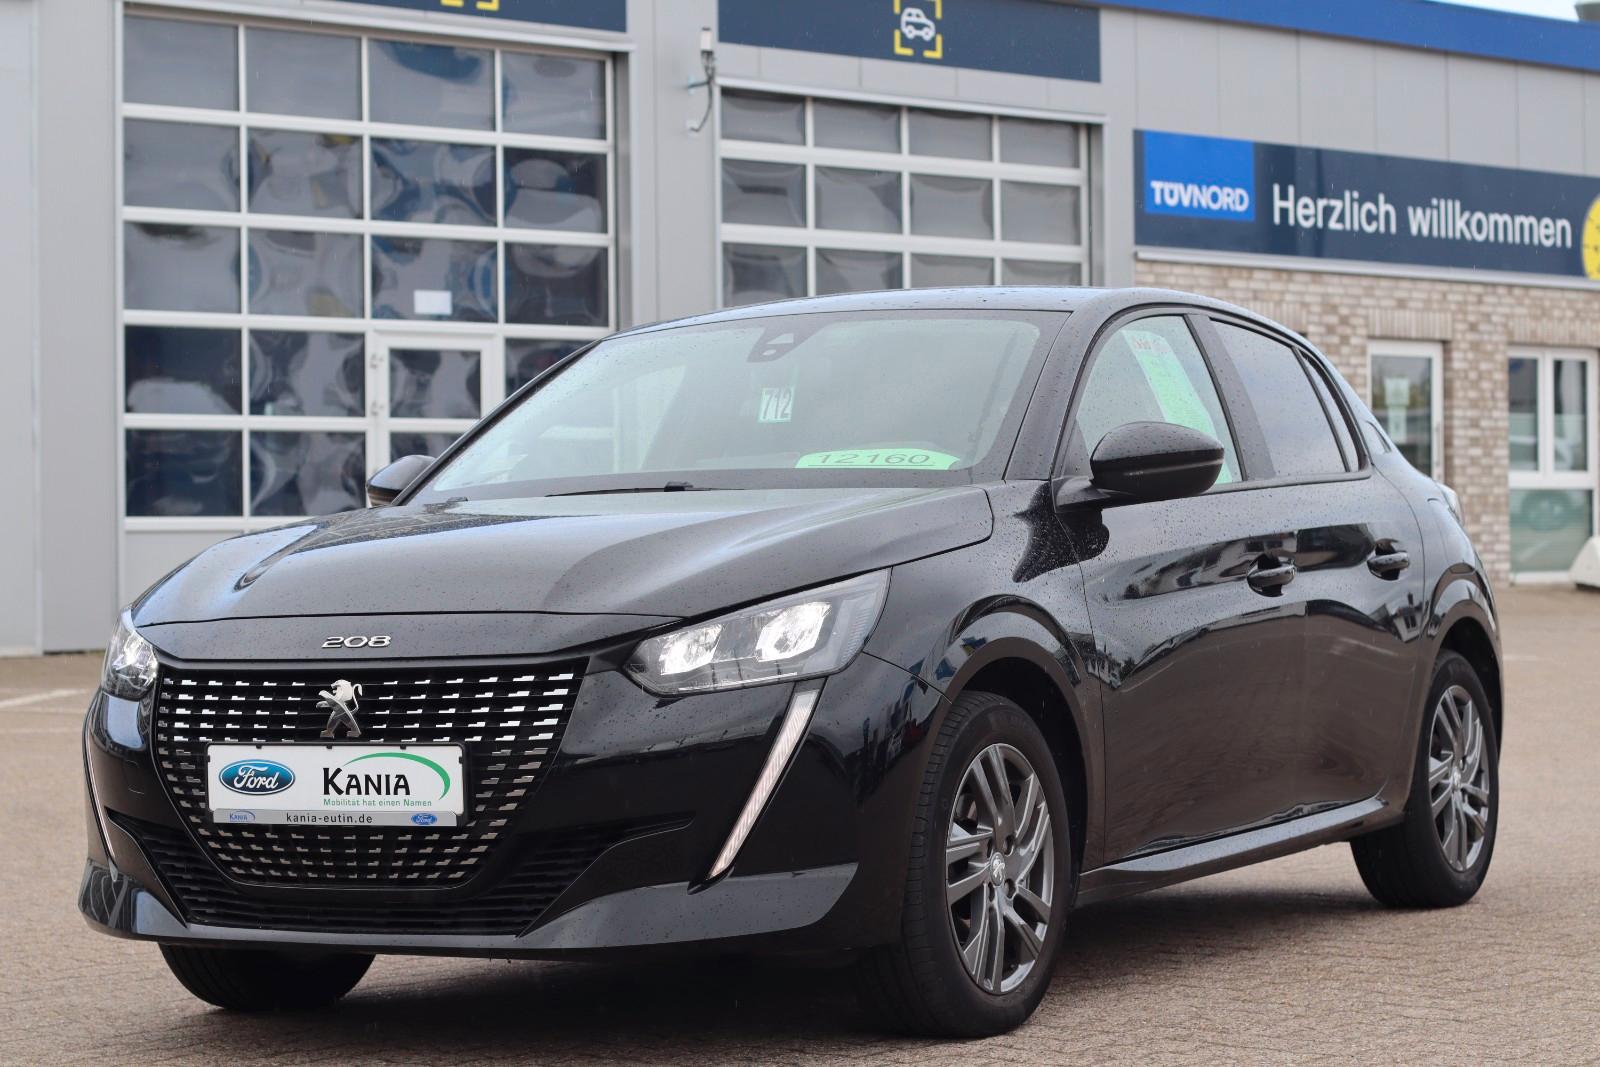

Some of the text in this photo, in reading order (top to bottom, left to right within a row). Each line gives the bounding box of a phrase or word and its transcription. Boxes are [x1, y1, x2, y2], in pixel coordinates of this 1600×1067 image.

[1272, 183, 1572, 248] Herzlich willkommen
[818, 453, 930, 464] 12160
[321, 635, 391, 648] 208
[233, 765, 280, 789] Ford
[323, 798, 432, 807] Mobilität hat einen Namen
[286, 812, 373, 824] kania-eutin.de
